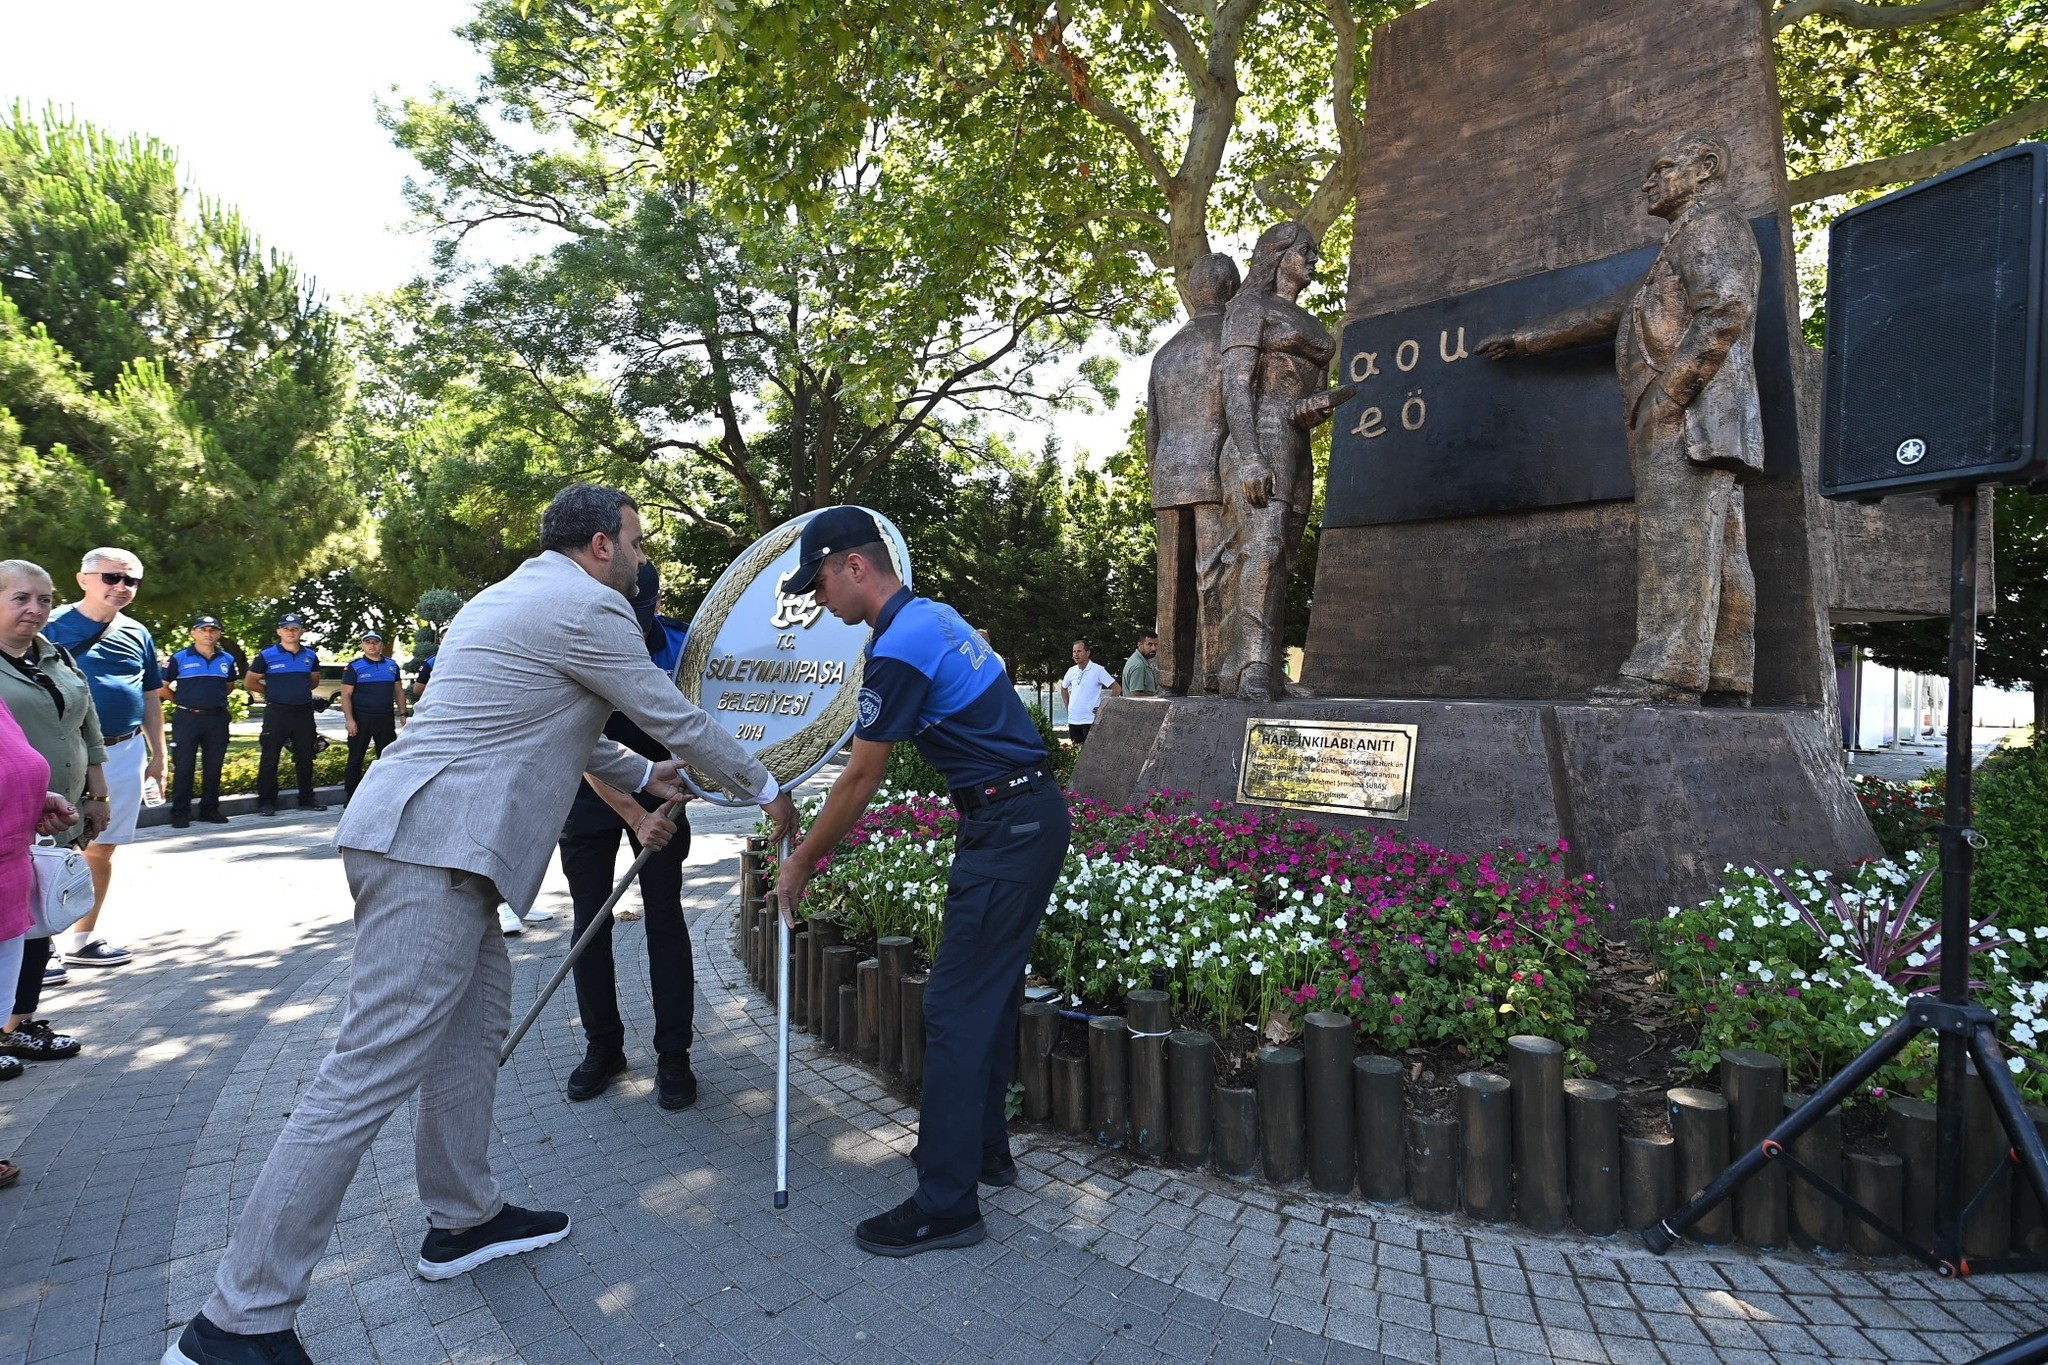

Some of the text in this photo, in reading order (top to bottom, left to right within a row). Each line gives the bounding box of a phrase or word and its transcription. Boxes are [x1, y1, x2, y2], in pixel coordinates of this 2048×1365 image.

[1351, 327, 1468, 382] a o u
[1351, 388, 1426, 437] e ö
[776, 633, 795, 650] T.C.
[706, 654, 845, 689] SÜLEYMANPAŞA
[717, 689, 813, 716] BELEDİYESİ
[735, 723, 765, 741] 2014
[1262, 733, 1395, 752] HARF İNKILABI ANITI
[1352, 758, 1370, 766] Kemal
